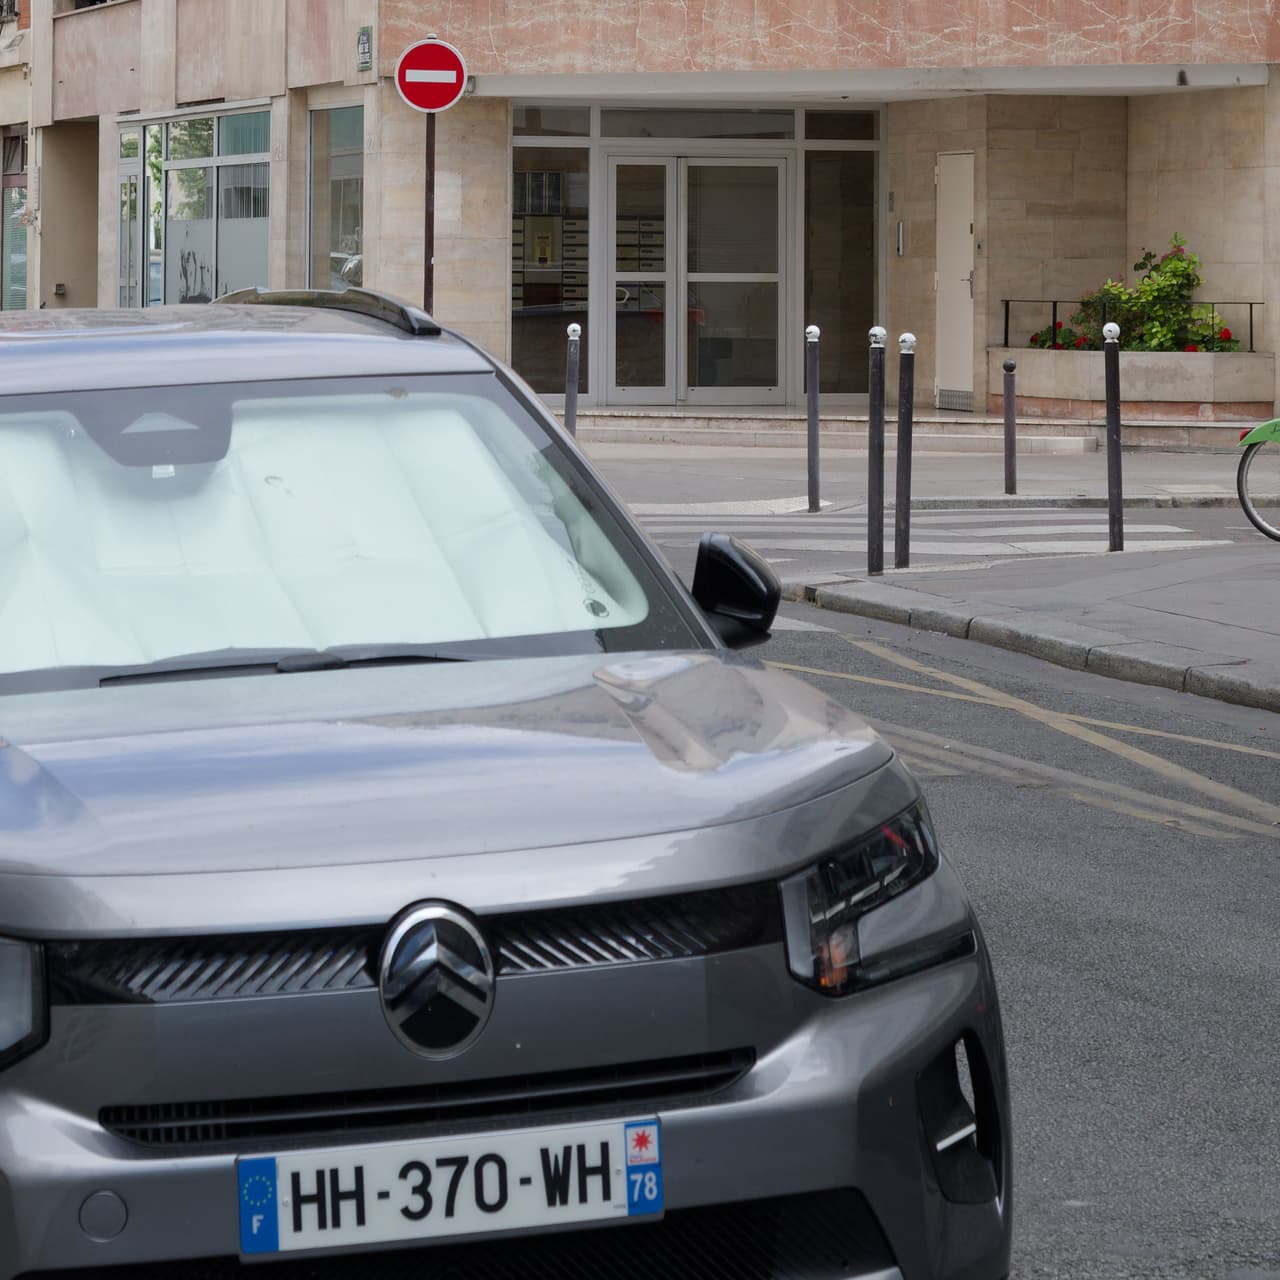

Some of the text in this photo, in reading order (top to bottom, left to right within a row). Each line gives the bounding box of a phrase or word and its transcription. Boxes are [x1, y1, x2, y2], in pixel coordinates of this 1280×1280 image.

[290, 1141, 613, 1233] HH-370-WH
[630, 1171, 658, 1202] 78
[251, 1214, 264, 1234] F
